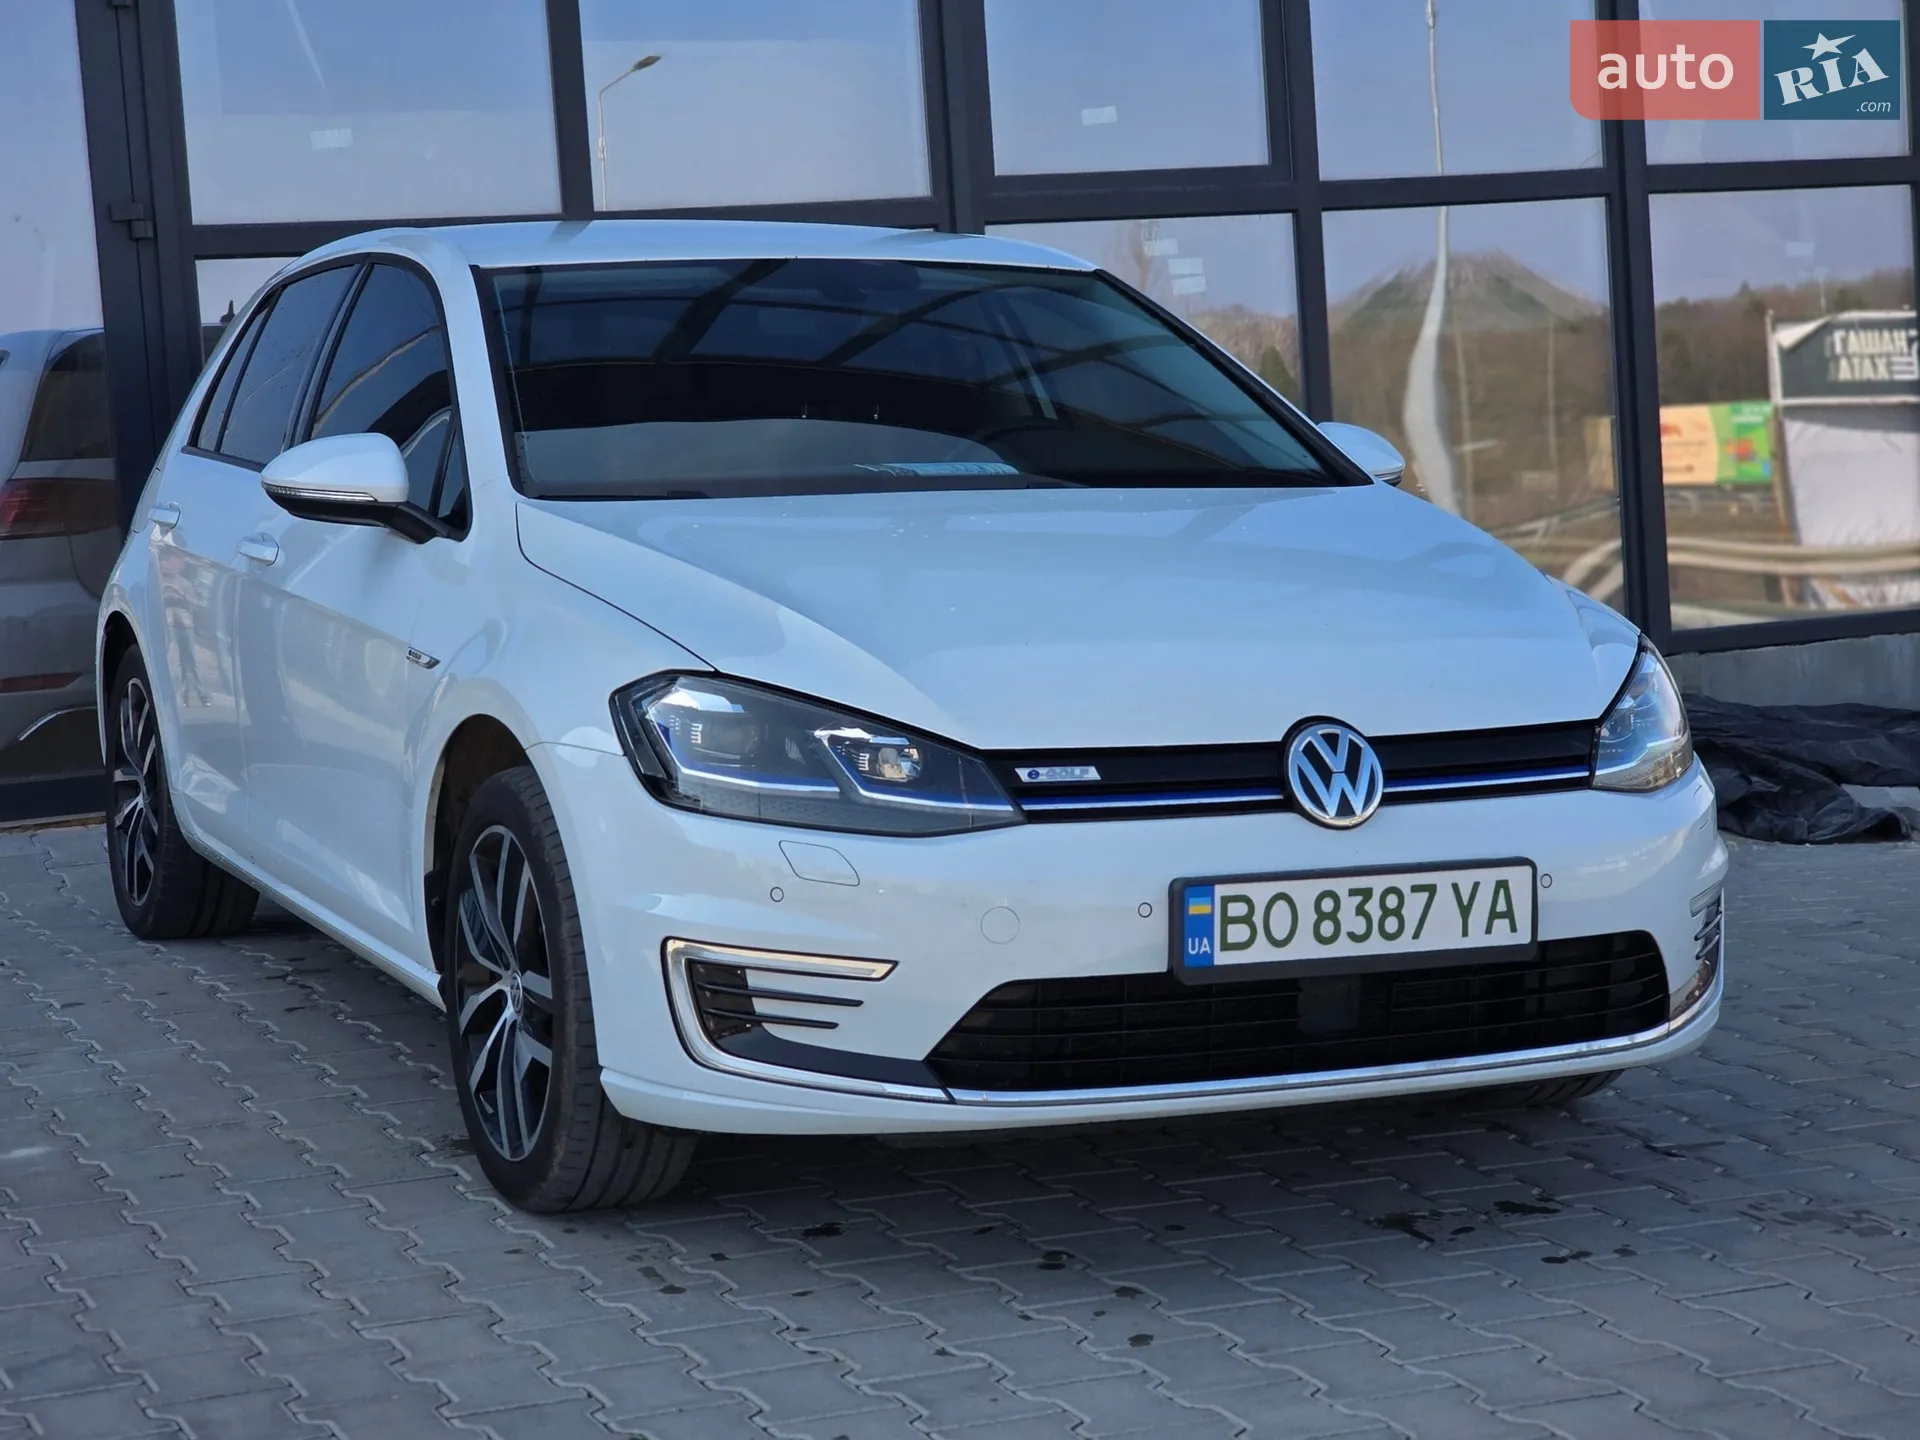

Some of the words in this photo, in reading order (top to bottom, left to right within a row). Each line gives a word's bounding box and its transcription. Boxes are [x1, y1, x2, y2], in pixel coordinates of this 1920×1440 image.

[1219, 891, 1299, 952] BO
[1313, 883, 1438, 946] 8387
[1451, 879, 1518, 938] YA
[1188, 938, 1211, 955] UA
